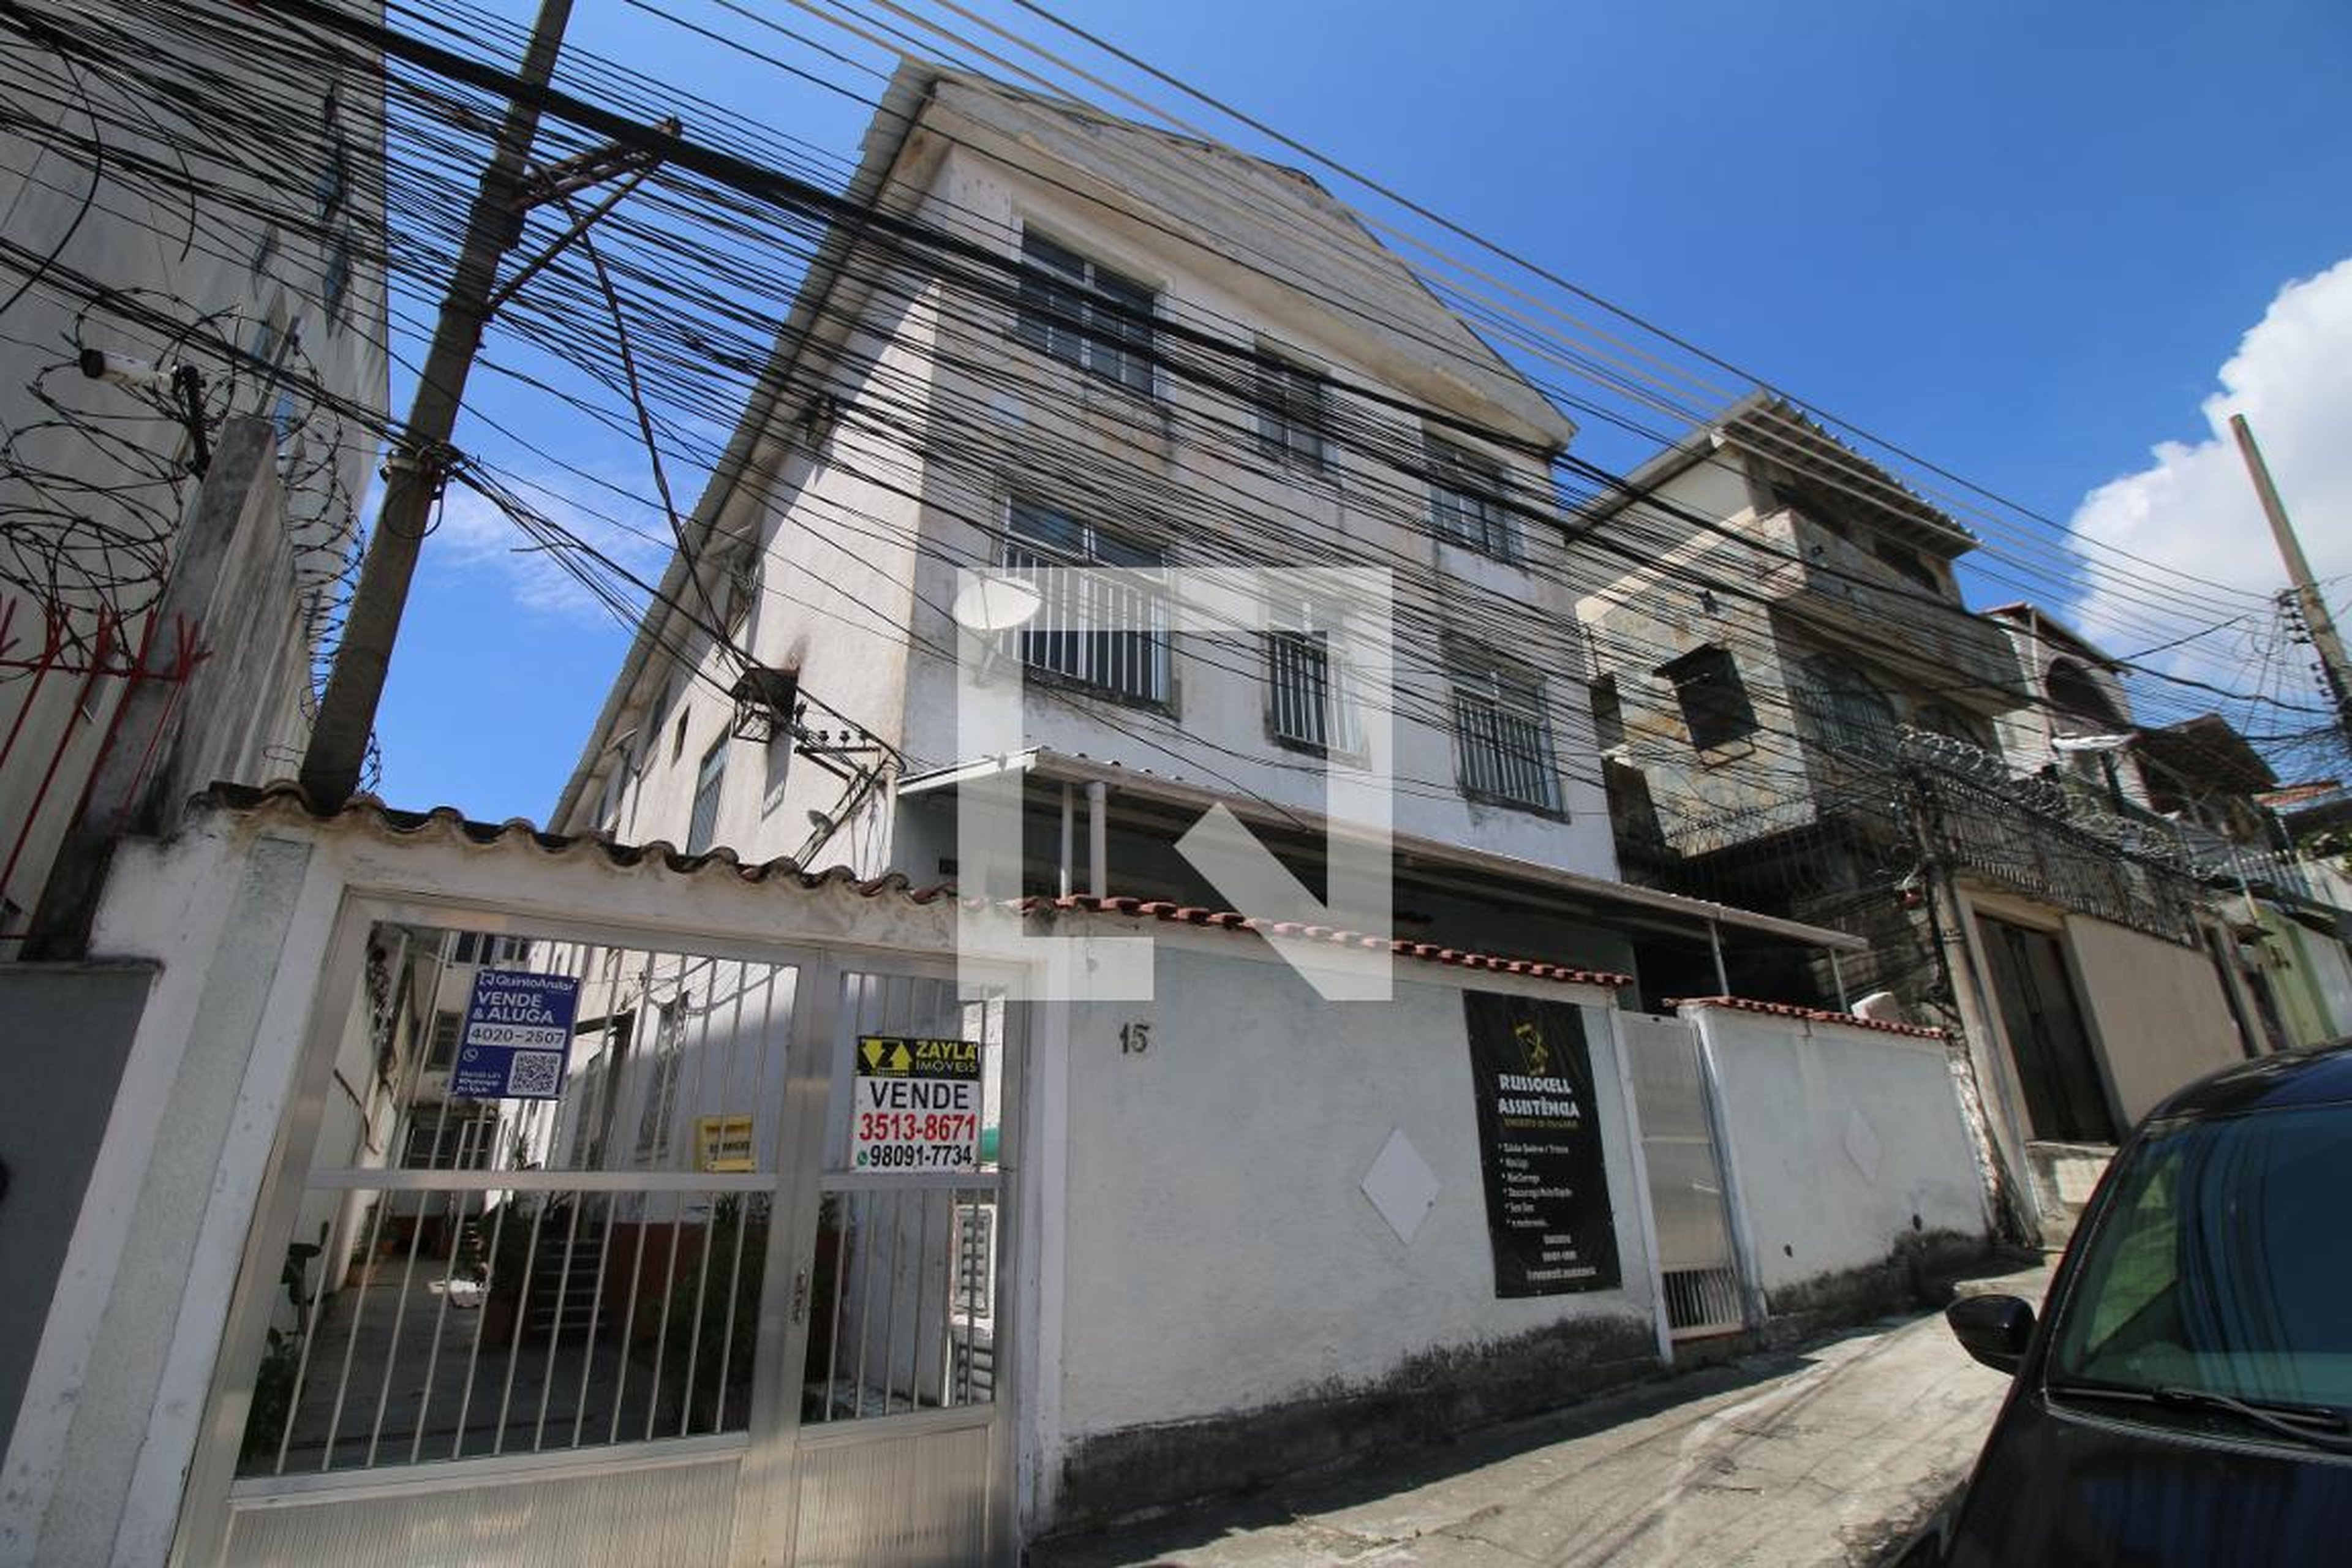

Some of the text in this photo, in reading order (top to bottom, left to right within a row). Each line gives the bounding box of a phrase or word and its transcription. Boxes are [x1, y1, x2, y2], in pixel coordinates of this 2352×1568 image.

[478, 991, 542, 1008] VENDE
[472, 1008, 554, 1023] & ALUGA
[471, 1028, 564, 1044] 4020-2507
[1120, 1022, 1150, 1054] 15
[916, 1041, 976, 1060] ZAYLA
[870, 1081, 969, 1109] VENDE
[860, 1113, 976, 1140] 3513-8671
[870, 1144, 973, 1166] 98091-7734
